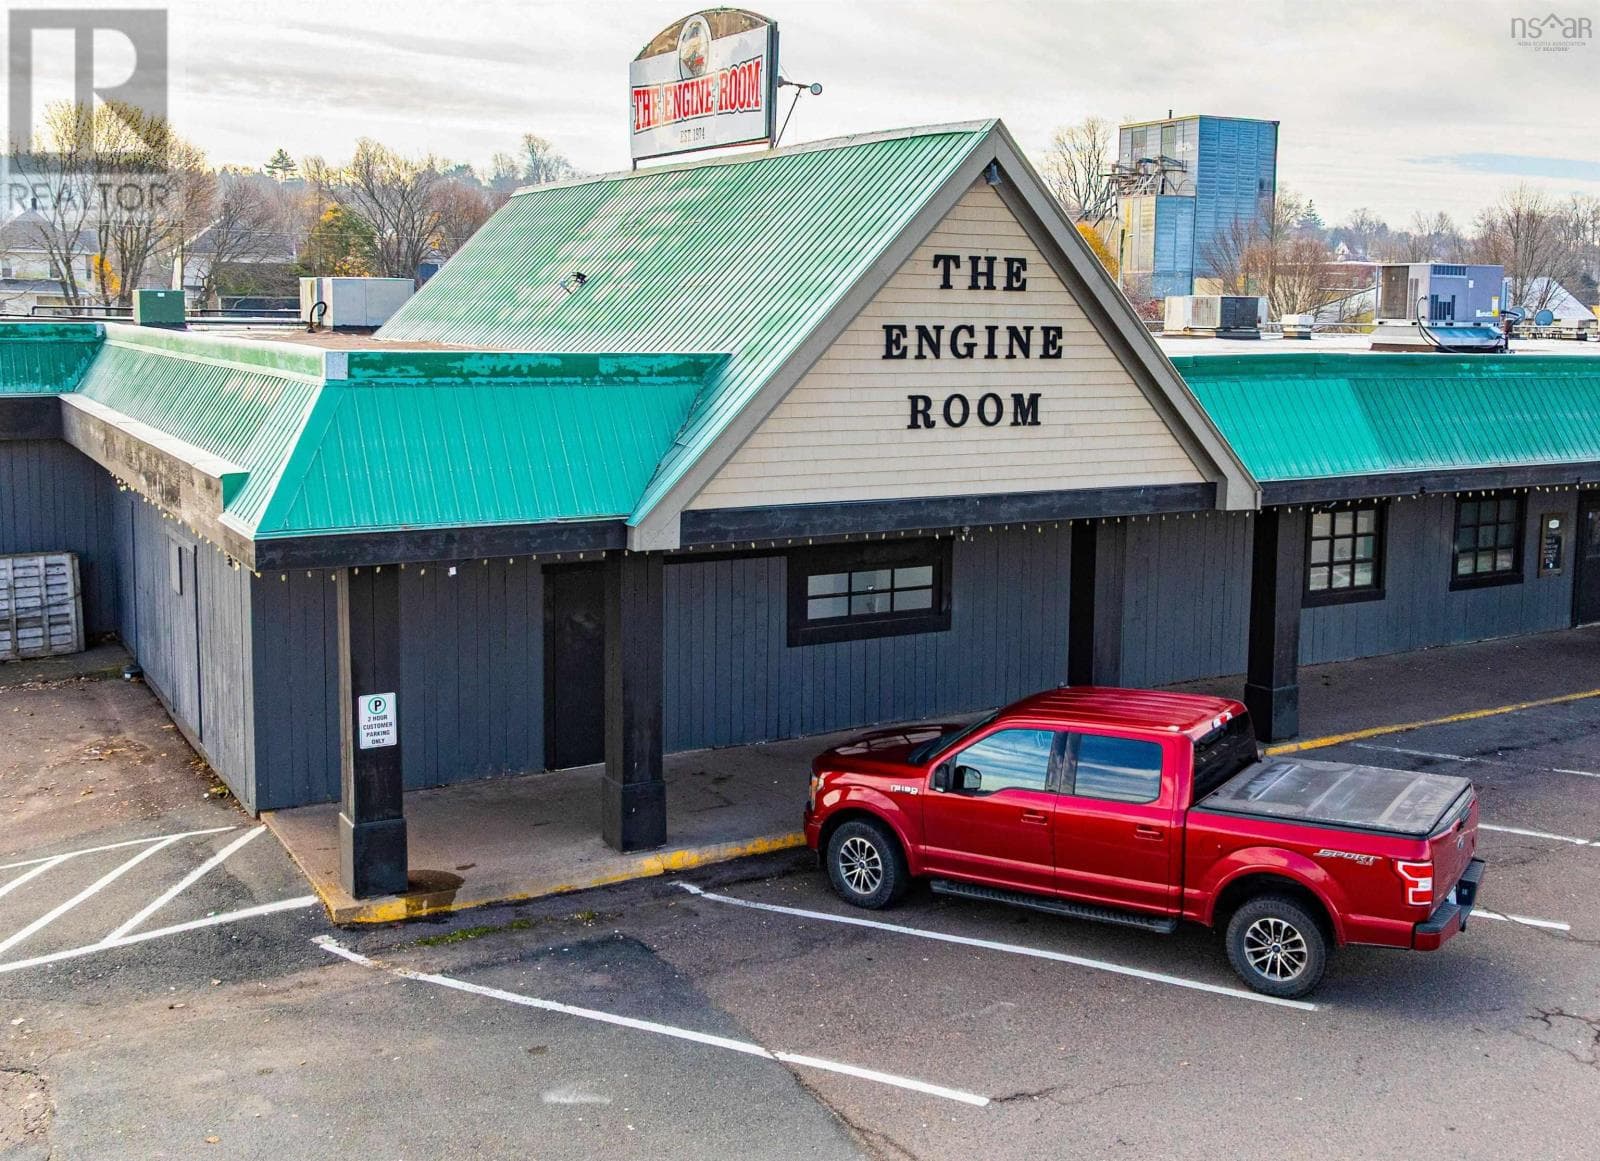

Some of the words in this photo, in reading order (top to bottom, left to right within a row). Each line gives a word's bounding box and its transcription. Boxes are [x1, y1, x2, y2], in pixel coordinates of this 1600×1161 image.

[633, 87, 660, 130] THE
[663, 76, 714, 120] ENGINE
[718, 60, 761, 111] ROOM
[933, 254, 1027, 291] THE
[882, 324, 1063, 360] ENGINE
[907, 392, 1042, 429] ROOM
[374, 700, 382, 711] P
[363, 721, 392, 730] CUSTOMER
[1318, 849, 1377, 862] SPORT
